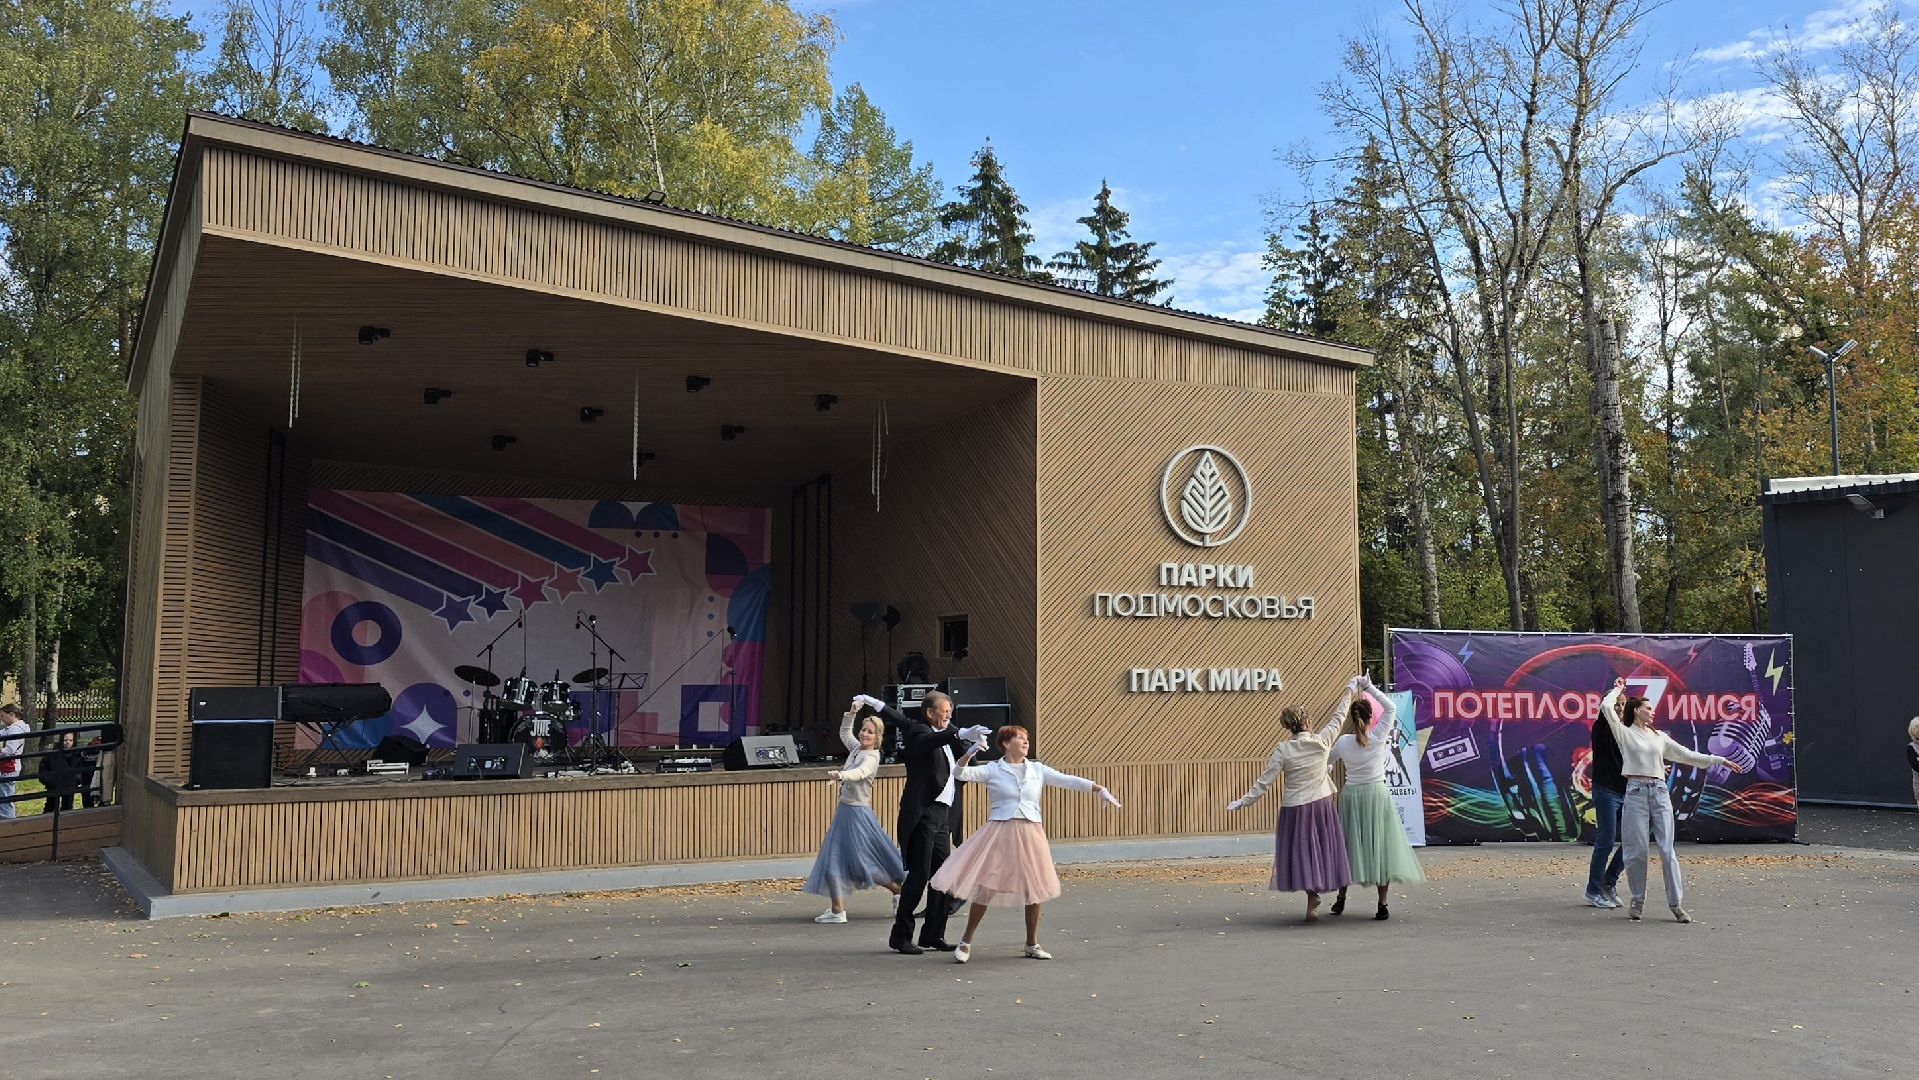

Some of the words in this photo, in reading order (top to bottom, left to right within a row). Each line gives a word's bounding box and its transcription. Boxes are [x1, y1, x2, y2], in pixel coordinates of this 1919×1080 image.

[1160, 562, 1254, 587] ПАРКИ
[1093, 592, 1315, 619] ПОДМОСКОВЬЯ
[1130, 668, 1203, 692] ПАРК
[1208, 668, 1282, 692] МИРА
